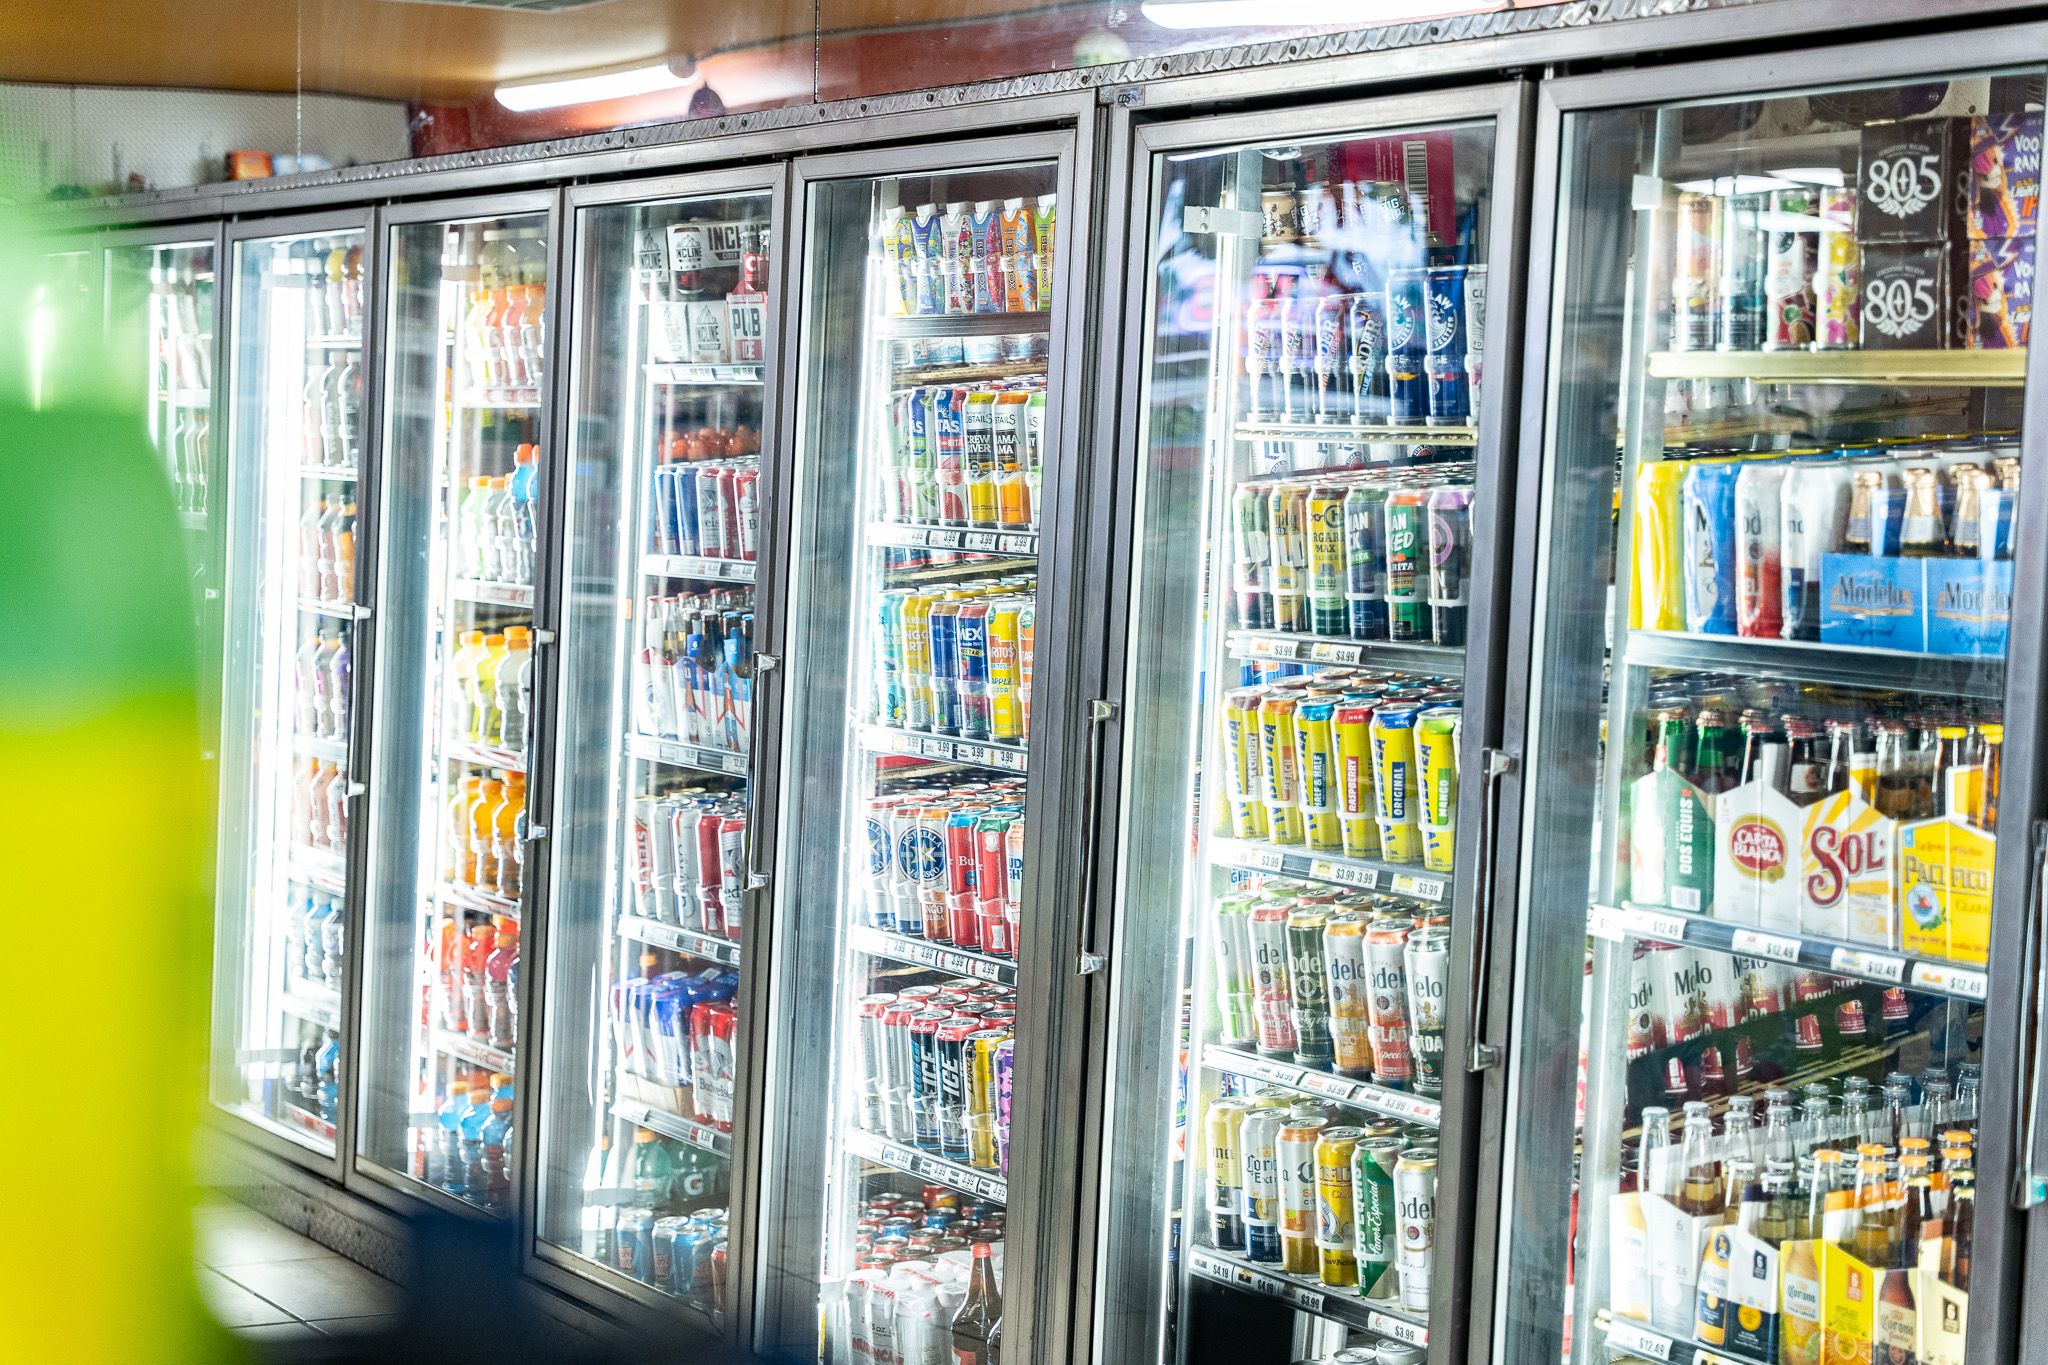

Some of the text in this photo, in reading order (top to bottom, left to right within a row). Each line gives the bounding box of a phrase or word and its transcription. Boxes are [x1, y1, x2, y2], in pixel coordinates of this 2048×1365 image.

[2014, 135, 2040, 153] VOO
[1866, 155, 1942, 203] 805
[1864, 278, 1936, 324] 805
[731, 308, 761, 336] PUB
[742, 341, 755, 358] ICE
[980, 534, 992, 545] 3.99
[1840, 576, 1904, 604] Modelo
[1945, 582, 2011, 610] Modlo
[1275, 645, 1293, 656] $3.99
[1336, 650, 1355, 662] $3.99
[938, 742, 950, 753] 3.99
[972, 747, 984, 758] 3.99
[1001, 751, 1014, 763] 3.99
[1347, 759, 1357, 812] RASPBERRY
[1394, 767, 1404, 815] ORIGINAL
[1439, 780, 1449, 817] MANGO
[1680, 797, 1693, 874] DOS EQUIS
[1736, 829, 1779, 849] CARTA
[1733, 841, 1781, 864] BLANCA
[1261, 855, 1279, 867] $3.99
[1808, 826, 1885, 906] SOL
[1336, 868, 1374, 884] $3.99 3.99
[1417, 881, 1438, 895] $3.99
[1653, 921, 1679, 936] $12.49
[1766, 943, 1794, 959] $12.49
[982, 961, 995, 974] 3.99
[1867, 962, 1897, 978] $12.49
[1950, 975, 1981, 990] $12.49
[942, 1052, 960, 1097] ICE
[1326, 1084, 1346, 1096] $3.99
[683, 1172, 704, 1196] G
[1367, 1179, 1384, 1227] Especial
[1757, 1253, 1764, 1268] 6
[1213, 1264, 1229, 1278] $4.19
[1257, 1279, 1274, 1293] $4.19
[1787, 1282, 1816, 1304] Corona
[1300, 1294, 1320, 1309] $3.99
[1946, 1303, 1956, 1320] 6
[1395, 1325, 1415, 1341] $3.99
[1639, 1338, 1665, 1356] $12.49
